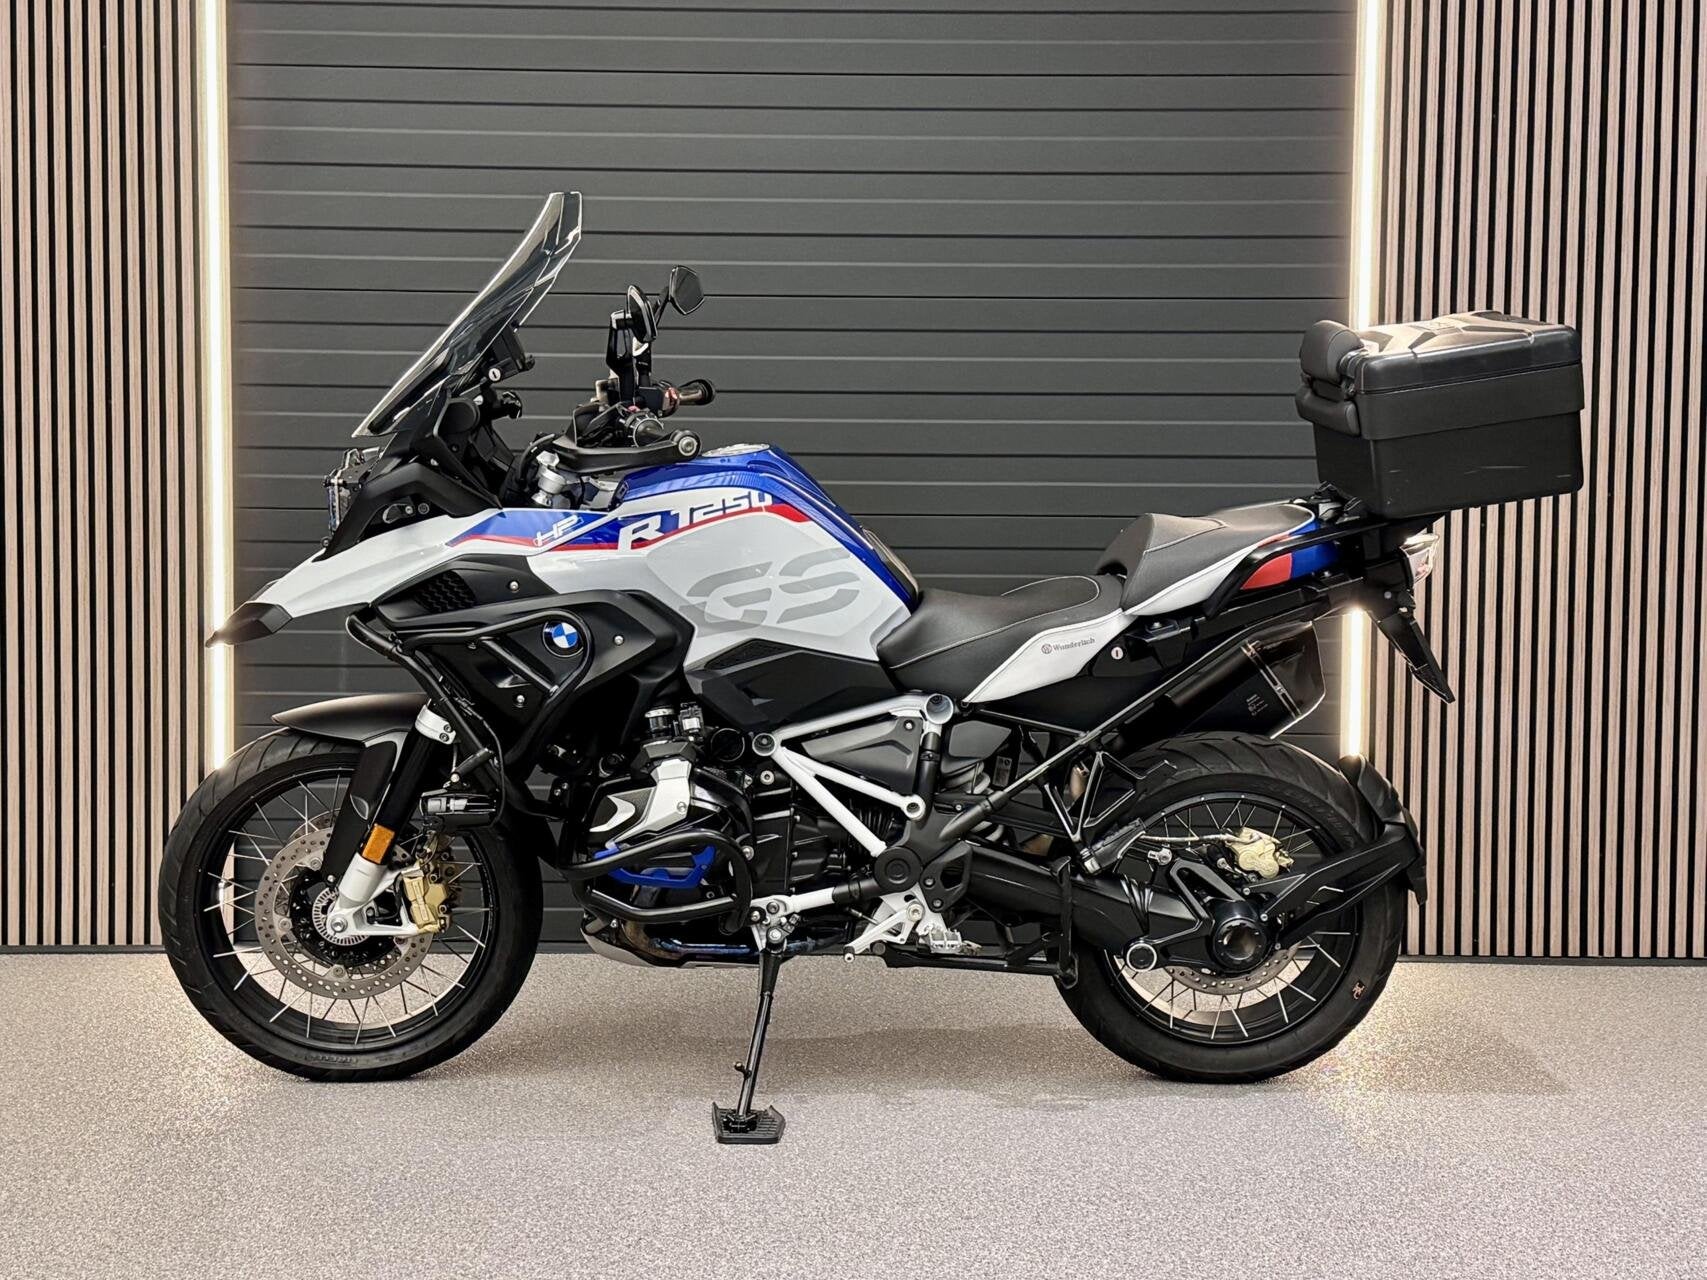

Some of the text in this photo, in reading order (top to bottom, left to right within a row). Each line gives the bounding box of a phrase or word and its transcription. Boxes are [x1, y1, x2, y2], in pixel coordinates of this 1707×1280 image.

[534, 514, 584, 547] HP
[618, 489, 773, 550] R 1250
[678, 547, 861, 638] GS
